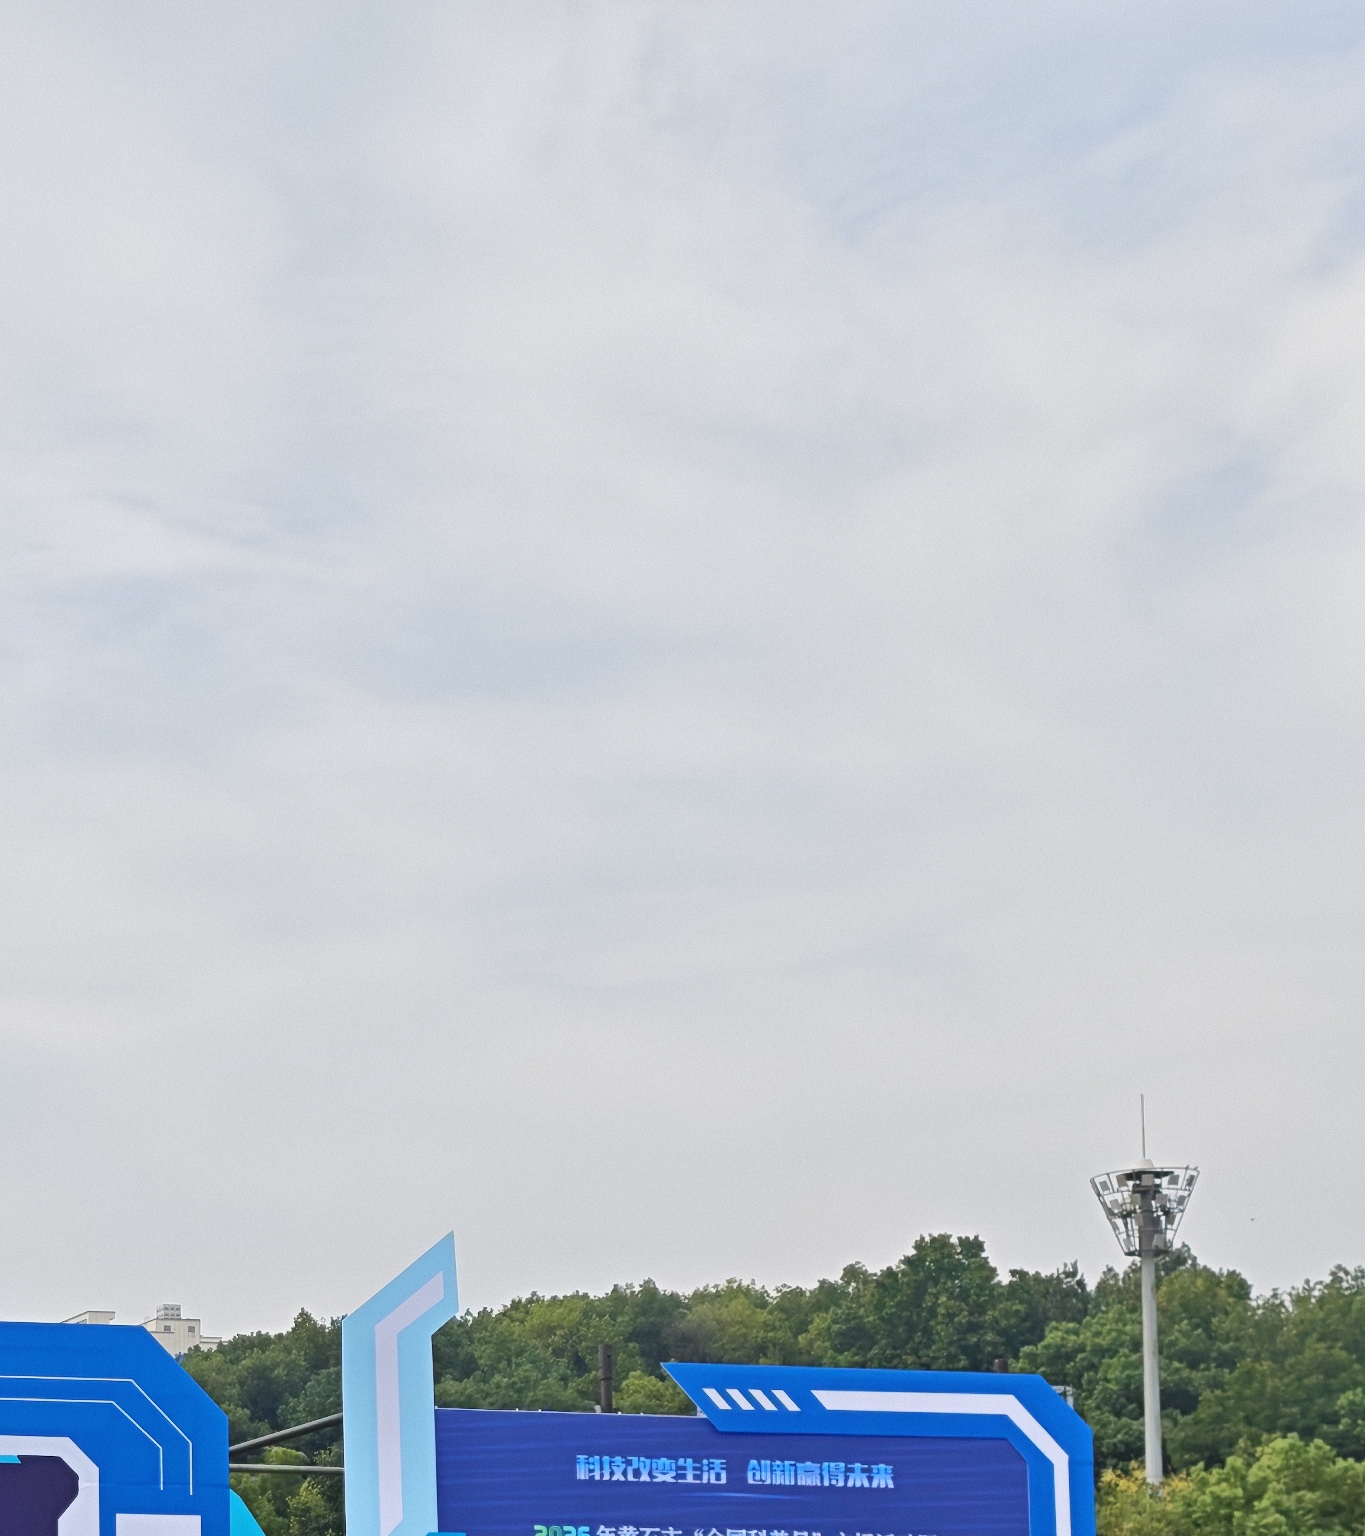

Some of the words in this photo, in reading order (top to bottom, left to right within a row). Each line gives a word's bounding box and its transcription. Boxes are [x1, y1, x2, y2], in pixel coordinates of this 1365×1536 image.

[576, 1454, 727, 1485] 科技改变生活
[746, 1459, 895, 1489] 创新赢得未来
